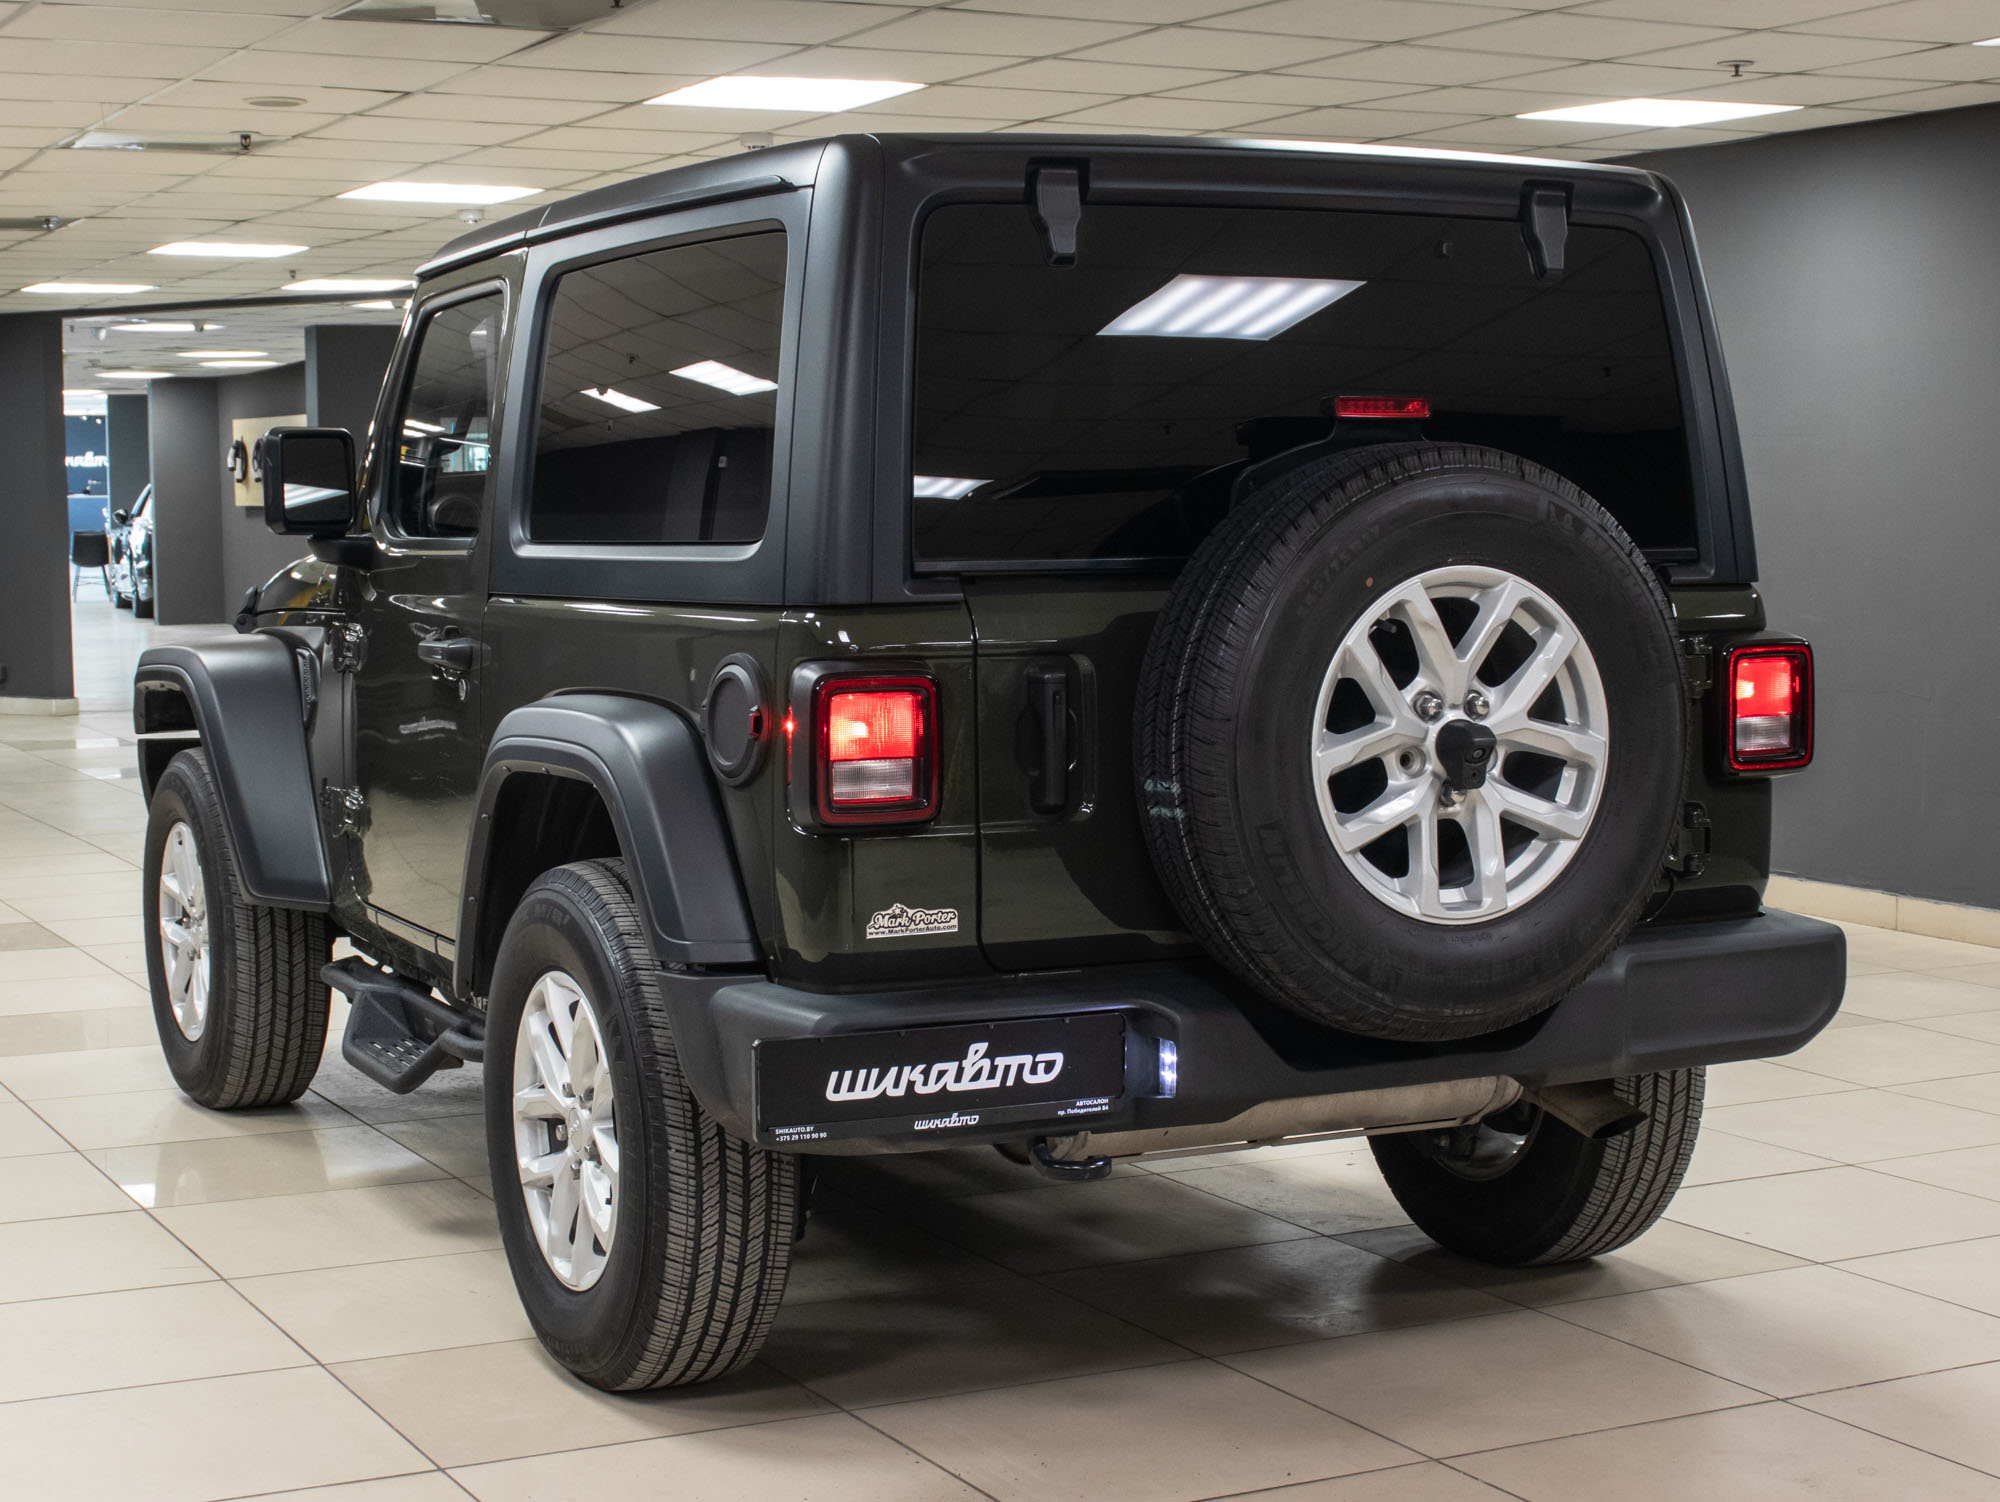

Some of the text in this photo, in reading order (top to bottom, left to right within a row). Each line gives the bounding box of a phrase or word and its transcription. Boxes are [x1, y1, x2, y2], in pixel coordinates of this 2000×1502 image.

[868, 910, 957, 930] Mark Porter
[868, 924, 957, 936] www.MarkPorterAuto.com
[825, 1042, 1064, 1102] шикавто
[1075, 1098, 1109, 1106] АВТОСАЛОН
[775, 1126, 814, 1135] SHIKAUTO.BY
